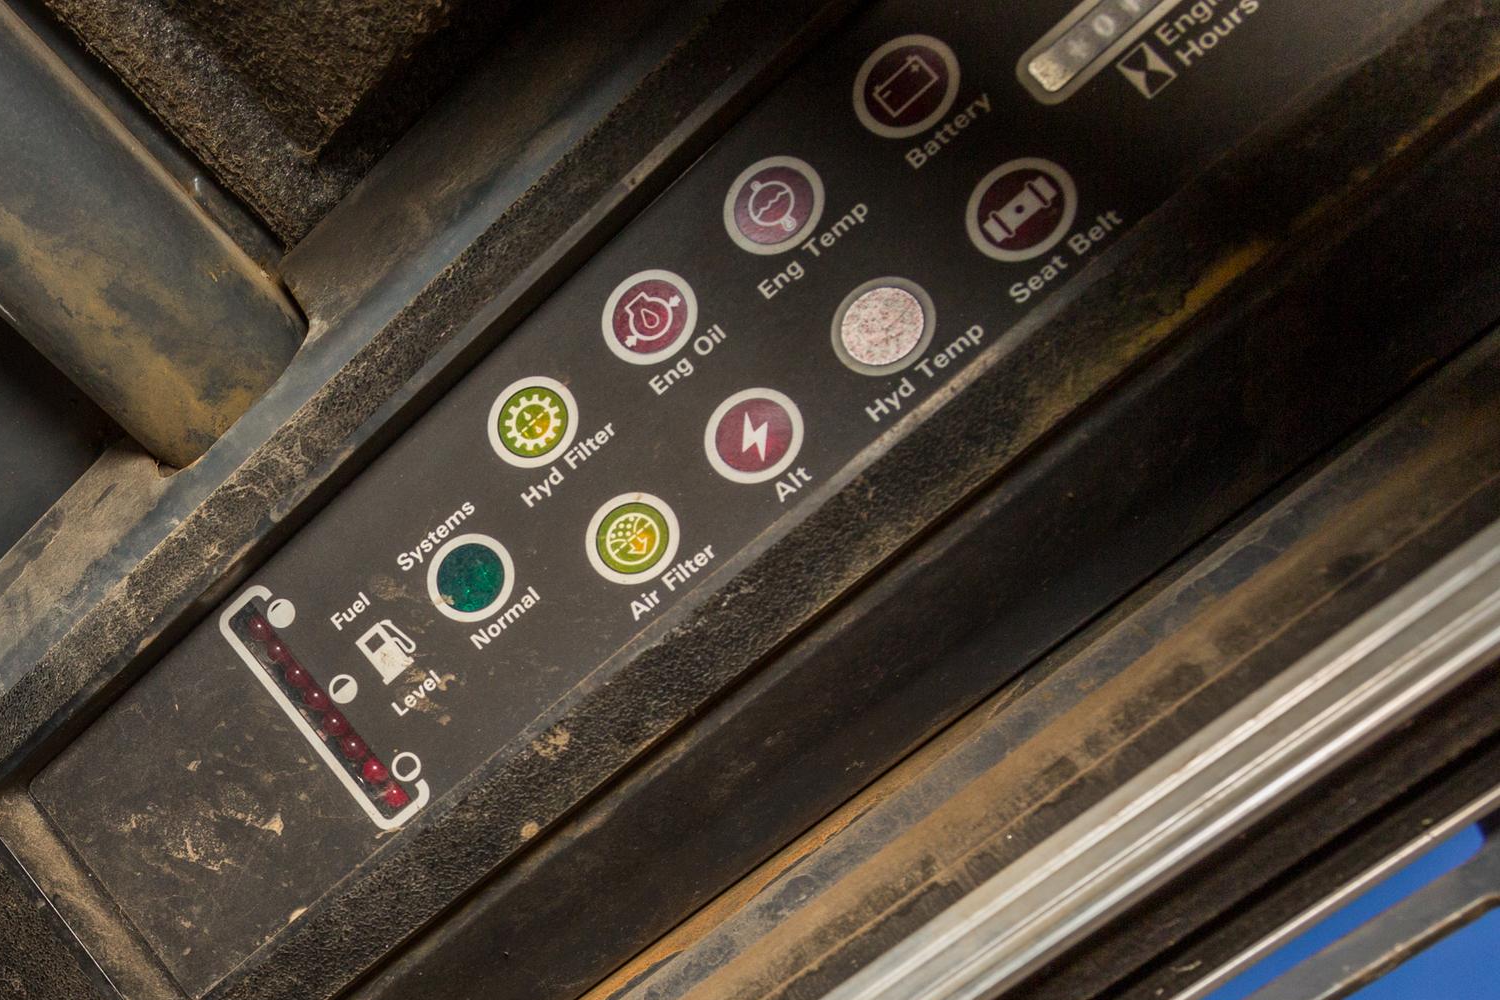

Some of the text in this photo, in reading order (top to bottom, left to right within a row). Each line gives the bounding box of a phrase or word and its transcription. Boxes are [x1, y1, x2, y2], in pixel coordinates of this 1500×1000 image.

[1175, 0, 1259, 66] Hours
[904, 92, 993, 171] Battery
[756, 200, 869, 300] Eng Temp
[1008, 208, 1124, 305] Seat Belt
[648, 323, 727, 396] Eng Oil
[864, 321, 986, 424] Hyd Temp
[520, 419, 617, 508] Hyd Filter
[773, 466, 813, 504] Alt
[396, 501, 476, 571] Systems
[330, 591, 371, 631] Fuel
[469, 585, 541, 650] Normal
[628, 541, 717, 622] Air Filter
[391, 669, 442, 717] Level
